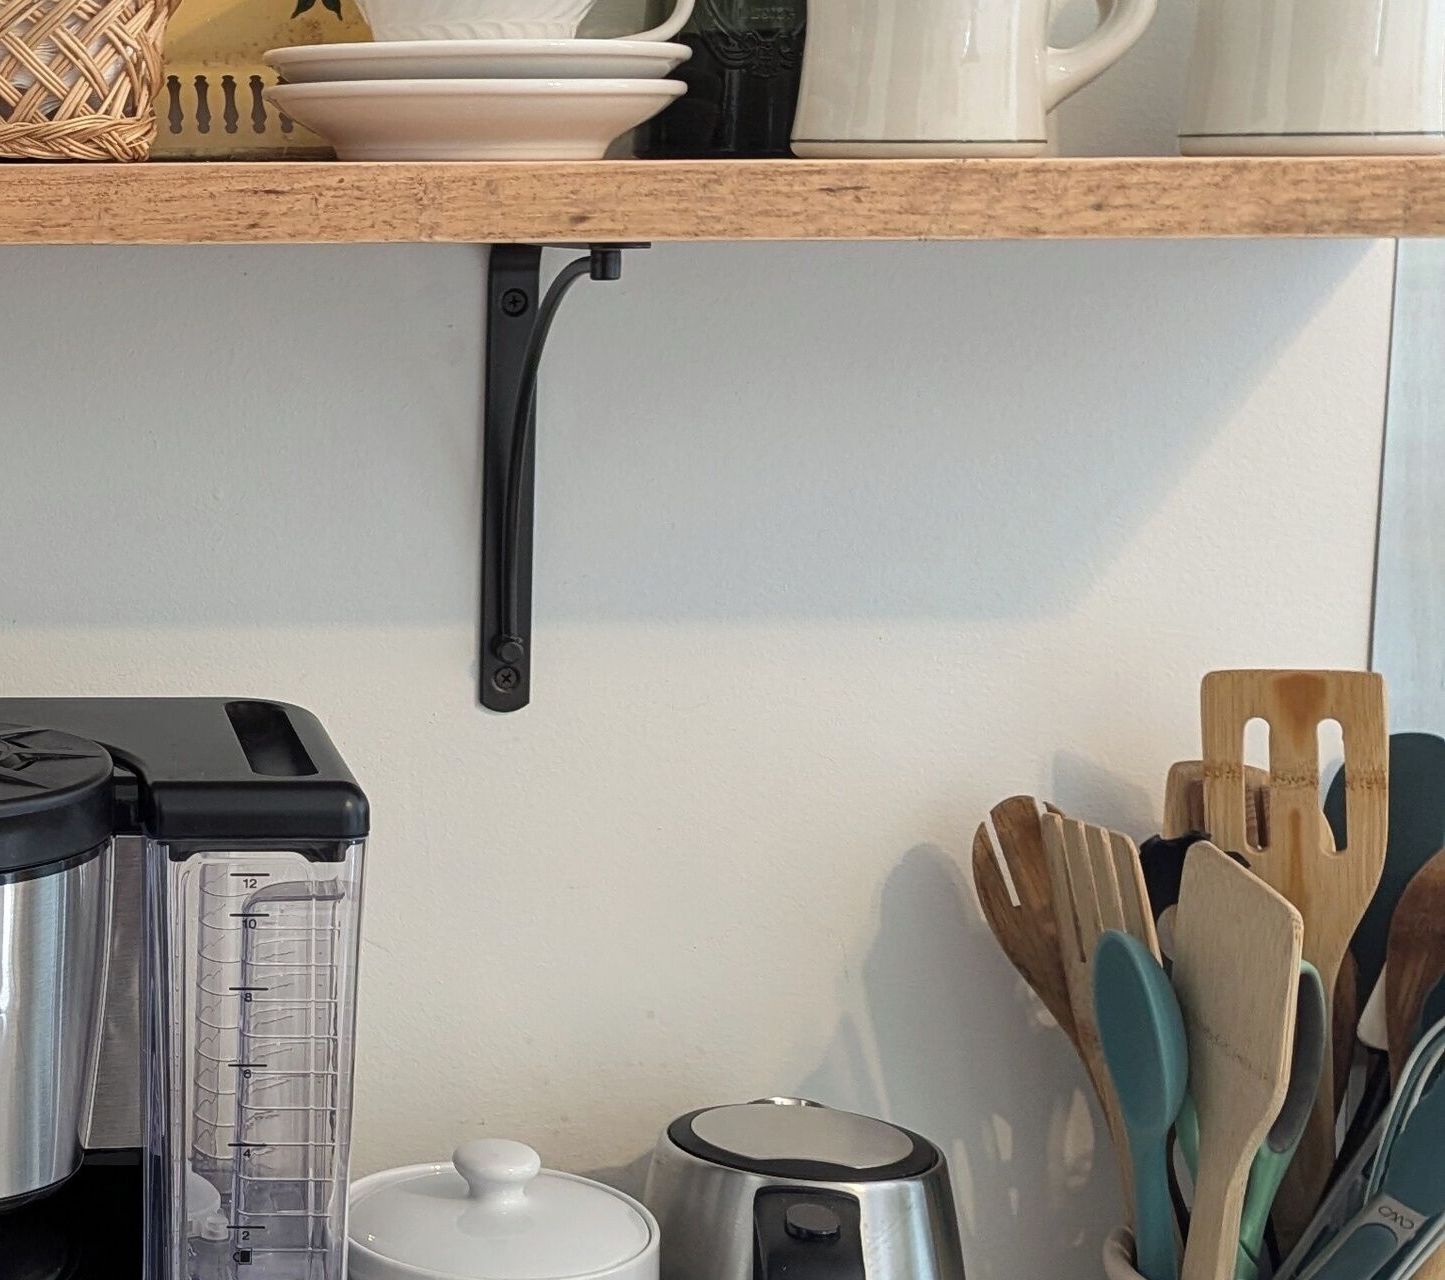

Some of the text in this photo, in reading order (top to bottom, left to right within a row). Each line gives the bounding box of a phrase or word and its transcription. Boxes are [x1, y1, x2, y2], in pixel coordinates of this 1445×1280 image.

[243, 879, 257, 889] 12
[242, 919, 257, 929] 10
[244, 992, 252, 1002] 8
[243, 1069, 252, 1079] 6
[243, 1148, 251, 1158] 4
[242, 1230, 250, 1241] 2
